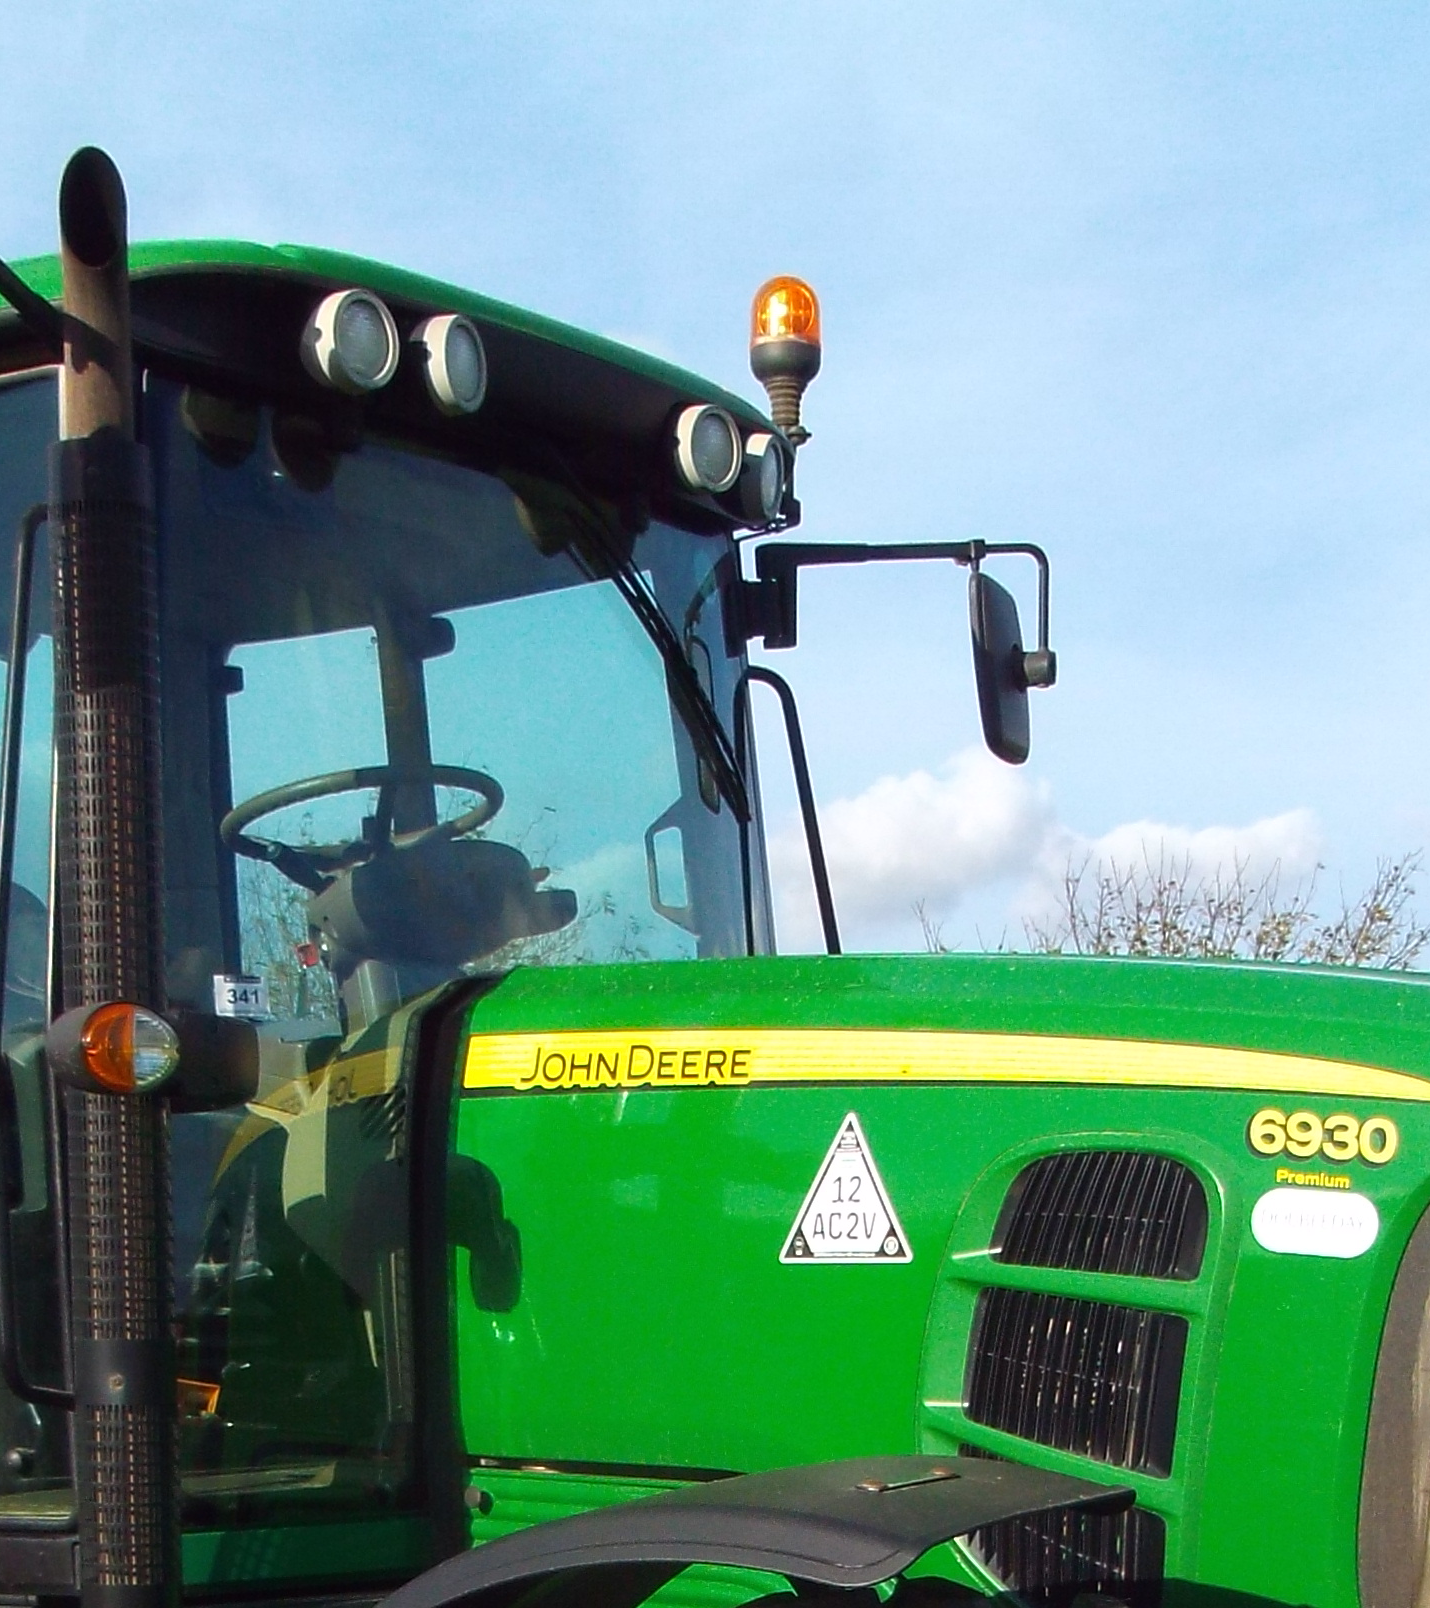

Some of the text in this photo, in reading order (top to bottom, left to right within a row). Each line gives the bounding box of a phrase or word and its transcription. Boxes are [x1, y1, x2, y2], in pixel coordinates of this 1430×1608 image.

[227, 988, 259, 1004] 341
[520, 1044, 751, 1083] JOHN DEERE
[1246, 1109, 1398, 1166] 6930
[832, 1176, 862, 1203] 12
[1276, 1168, 1350, 1189] Premium
[812, 1212, 877, 1240] AC2V
